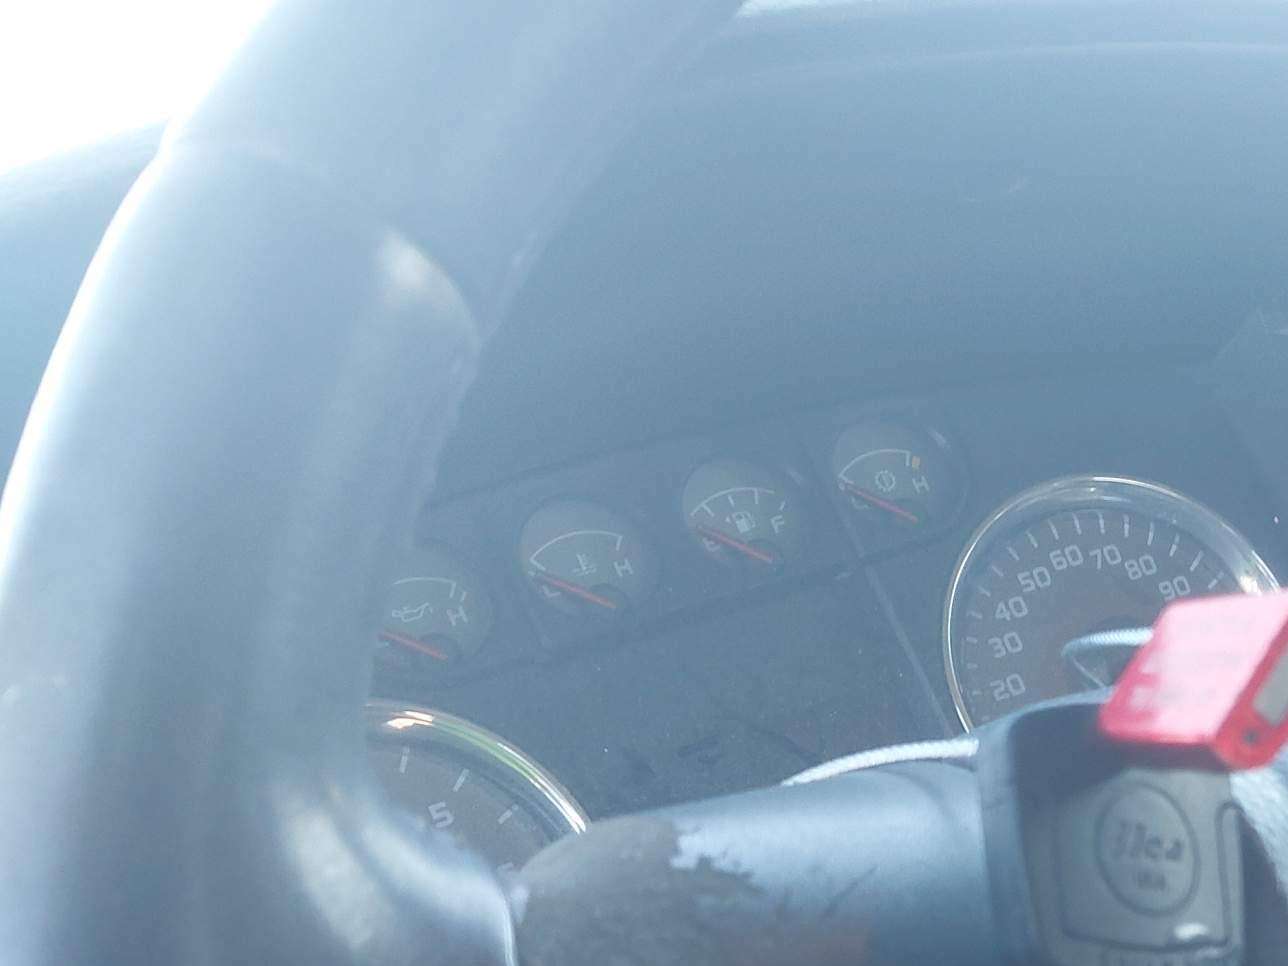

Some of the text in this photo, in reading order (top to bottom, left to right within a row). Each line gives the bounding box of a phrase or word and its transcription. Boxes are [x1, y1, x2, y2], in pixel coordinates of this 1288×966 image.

[911, 476, 930, 493] H
[770, 515, 784, 534] F
[613, 558, 632, 577] H
[1049, 544, 1083, 570] 60
[1089, 544, 1122, 569] 70
[1124, 555, 1158, 581] 80
[1017, 565, 1052, 592] 50
[1158, 575, 1192, 601] 90
[446, 606, 468, 627] H
[993, 596, 1028, 622] 40
[988, 631, 1023, 659] 30
[990, 673, 1026, 701] 20
[428, 801, 455, 829] 5
